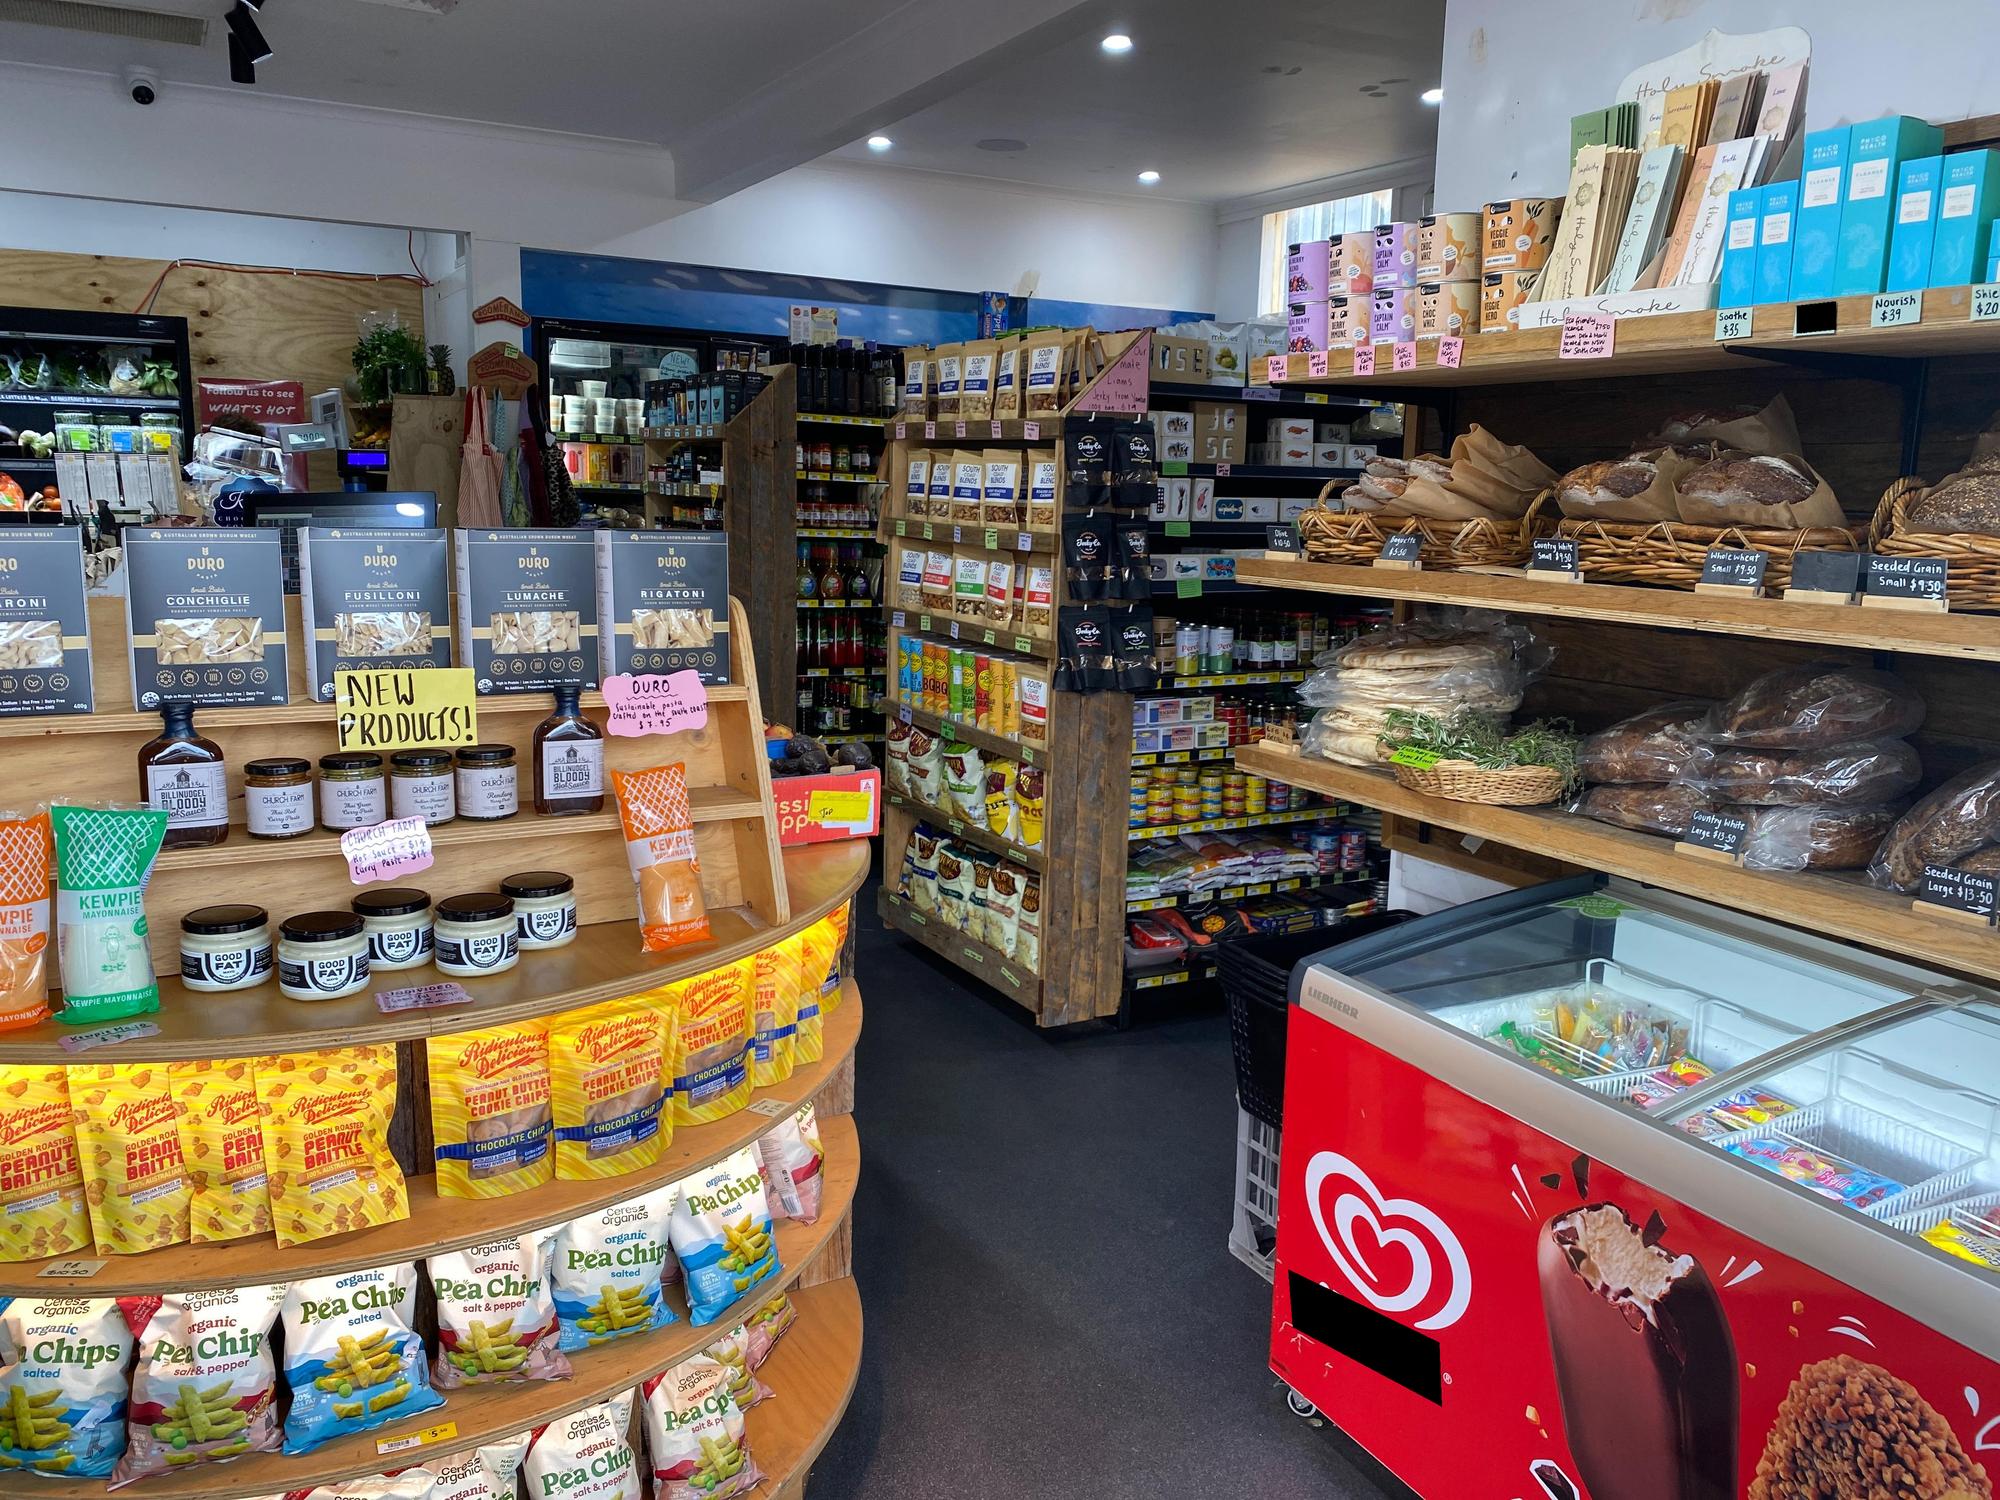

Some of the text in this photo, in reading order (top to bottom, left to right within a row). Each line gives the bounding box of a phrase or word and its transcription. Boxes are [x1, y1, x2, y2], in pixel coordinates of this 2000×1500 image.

[1700, 55, 1786, 83] Smoke
[1860, 141, 1887, 150] HEALTH
[1813, 151, 1839, 160] HEALTH
[1490, 229, 1509, 240] VEGGIE
[1420, 242, 1433, 252] CHOC
[1491, 238, 1506, 250] HERO
[1375, 250, 1393, 260] CAPTAIN
[1420, 251, 1432, 261] WHIZ
[1377, 258, 1390, 269] CALM
[1484, 301, 1500, 312] VEGGIE
[1875, 295, 1916, 310] Nourish
[1422, 309, 1436, 319] CHOC
[1485, 311, 1498, 321] HERO
[1880, 308, 1902, 322] $39
[1976, 302, 1999, 317] $20
[1374, 313, 1393, 323] CAPTAIN
[1422, 319, 1435, 328] WHIZ
[1719, 312, 1748, 322] Soothe
[1722, 322, 1740, 337] $35
[206, 387, 295, 399] Follow us to see
[208, 403, 297, 416] WHAT'S HOT
[962, 464, 980, 473] SOUTH
[991, 463, 1009, 472] SOUTH
[959, 476, 977, 485] BLENDS
[1274, 529, 1288, 538] Olive
[1389, 535, 1417, 546] Baguette
[1533, 541, 1573, 552] Country White
[363, 555, 398, 568] DURO
[518, 557, 550, 569] DURO
[1710, 551, 1760, 563] Whole wheat
[187, 557, 225, 572] DURO
[1871, 560, 1942, 574] Seeded Grain
[960, 572, 977, 580] BLENDS
[1879, 577, 1906, 588] Small
[166, 594, 251, 606] CONCHIGLIE
[344, 591, 421, 601] FUSILLONI
[506, 592, 565, 601] LUMACHE
[640, 590, 706, 599] RIGATONI
[346, 672, 415, 709] NEW
[615, 700, 683, 713] Sustainable pasta
[339, 705, 474, 748] PRODUCTS!
[553, 766, 591, 774] BILLINUDGEL
[553, 772, 590, 783] BLOODY
[568, 780, 590, 790] Sauce
[160, 790, 206, 800] BILLINUDGEL
[262, 793, 306, 805] CHURCH FARM
[336, 788, 378, 798] CHURCH FARM
[486, 791, 513, 800] Rendang
[161, 798, 207, 811] BLOODY
[1693, 810, 1746, 831] Country White
[649, 833, 695, 853] KEWPIE
[354, 863, 378, 877] Curry
[382, 857, 402, 868] Paste
[1924, 865, 1993, 890] Seeded Grain
[1928, 879, 1954, 896] Large
[79, 890, 141, 909] KEWPIE
[82, 906, 139, 920] MAYONNAISE
[536, 919, 559, 929] FAT
[214, 952, 243, 962] GOOD
[215, 960, 243, 970] FAT
[318, 959, 345, 969] GOOD
[318, 967, 345, 978] FAT
[687, 980, 742, 1020] Delicious
[1308, 985, 1360, 1020] LIEBHERR
[69, 1022, 152, 1043] Kewpie Mayo
[574, 1013, 660, 1056] Ridiculously
[688, 1021, 745, 1052] COOKIE CHIPS
[583, 1056, 663, 1092] PEANUT BUTTER
[589, 1071, 661, 1101] COOKIE CHIPS
[288, 1088, 373, 1118] Ridiculously
[303, 1099, 370, 1126] Delicious
[593, 1103, 656, 1135] CHOCOLATE CHIP
[222, 1127, 254, 1142] GOLDEN
[303, 1121, 364, 1141] GOLDEN ROASTED
[304, 1129, 362, 1156] PEANUT
[475, 1125, 545, 1153] CHOCOLATE CHIP
[0, 1135, 74, 1162] GOLDEN ROASTED
[304, 1142, 365, 1170] BRITTLE
[0, 1157, 78, 1192] BRITTLE
[306, 1169, 322, 1179] 100%
[323, 1160, 355, 1175] AUSTRALIAN
[474, 1260, 520, 1274] organic
[610, 1268, 641, 1278] salted
[335, 1270, 385, 1289] organic
[33, 1304, 90, 1317] Organics
[462, 1299, 526, 1315] salt & pepper
[347, 1311, 383, 1327] salted
[33, 1337, 121, 1370] Chips
[23, 1368, 61, 1379] salted
[174, 1357, 250, 1377] salt & pepper
[677, 1369, 719, 1394] Organics
[570, 1415, 600, 1431] Ceres
[664, 1405, 703, 1432] Pea
[567, 1419, 611, 1440] Organics
[575, 1437, 617, 1459] organic
[441, 1460, 475, 1476] Ceres
